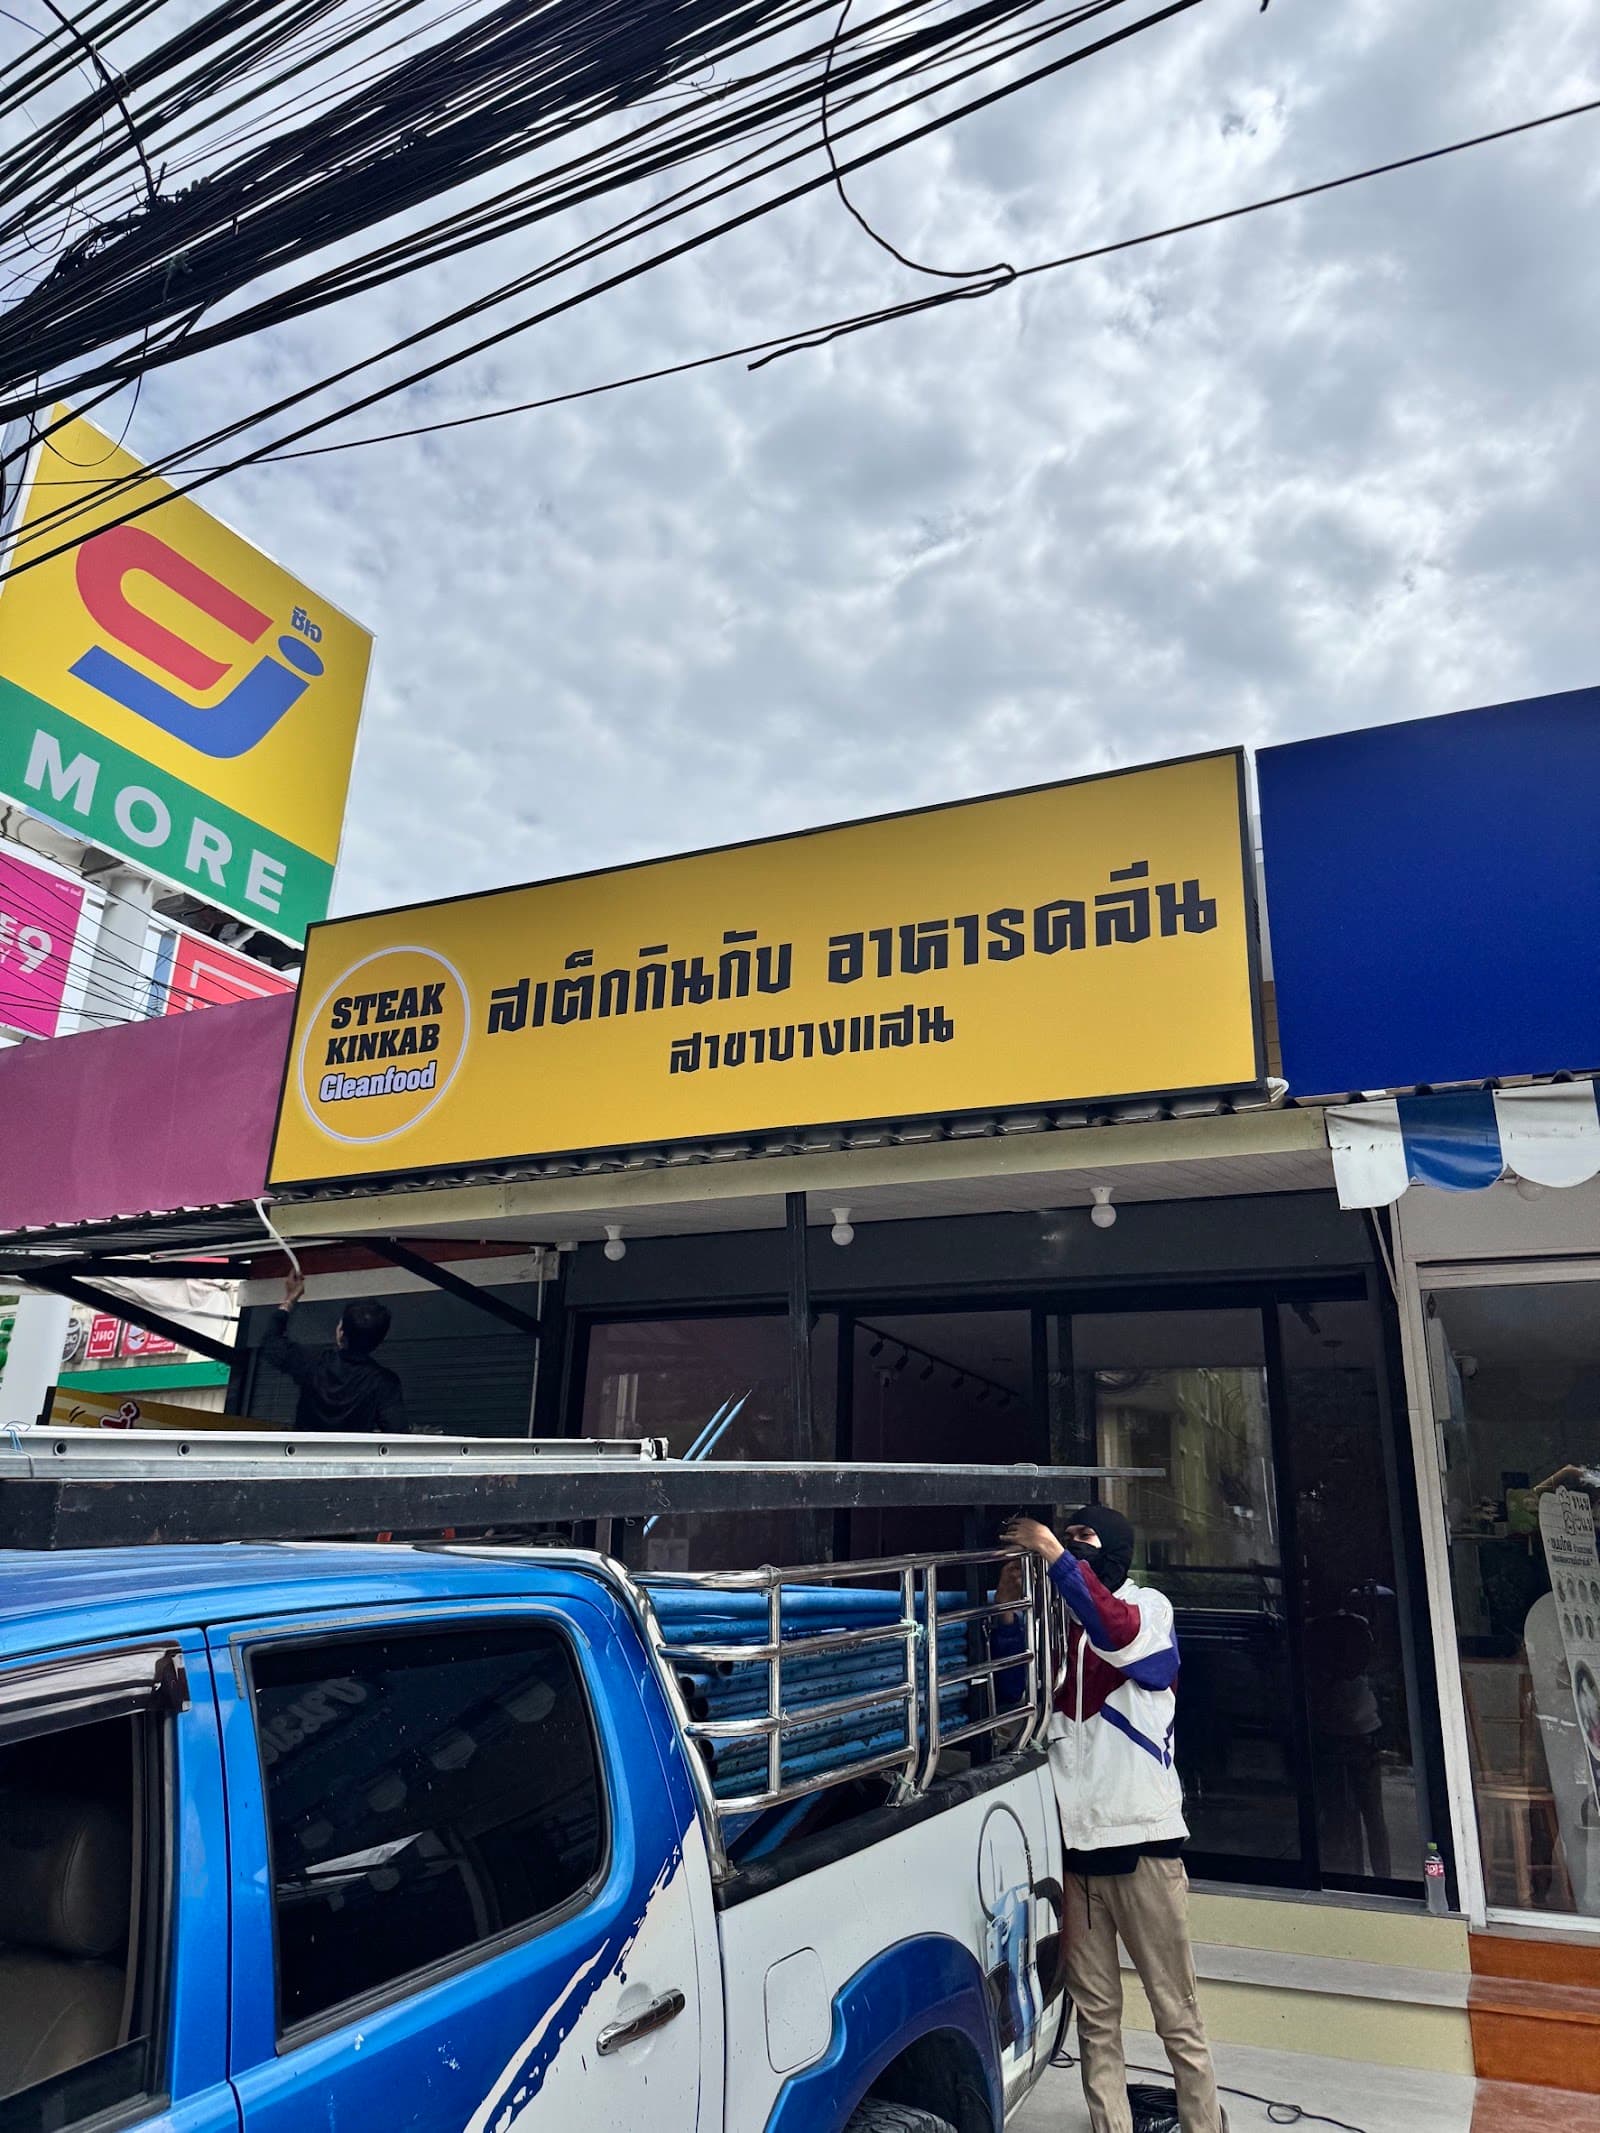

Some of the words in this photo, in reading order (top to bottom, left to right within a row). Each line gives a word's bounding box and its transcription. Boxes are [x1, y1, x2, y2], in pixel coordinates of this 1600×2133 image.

[23, 728, 287, 915] MORE
[486, 930, 793, 1035] สเต็กกินกับ
[827, 860, 1218, 985] อาหารคลีน
[330, 982, 446, 1030] STEAK
[325, 1023, 441, 1066] KINKAB
[669, 1003, 954, 1074] สาขาบางแสน
[319, 1061, 438, 1103] Cleanfood
